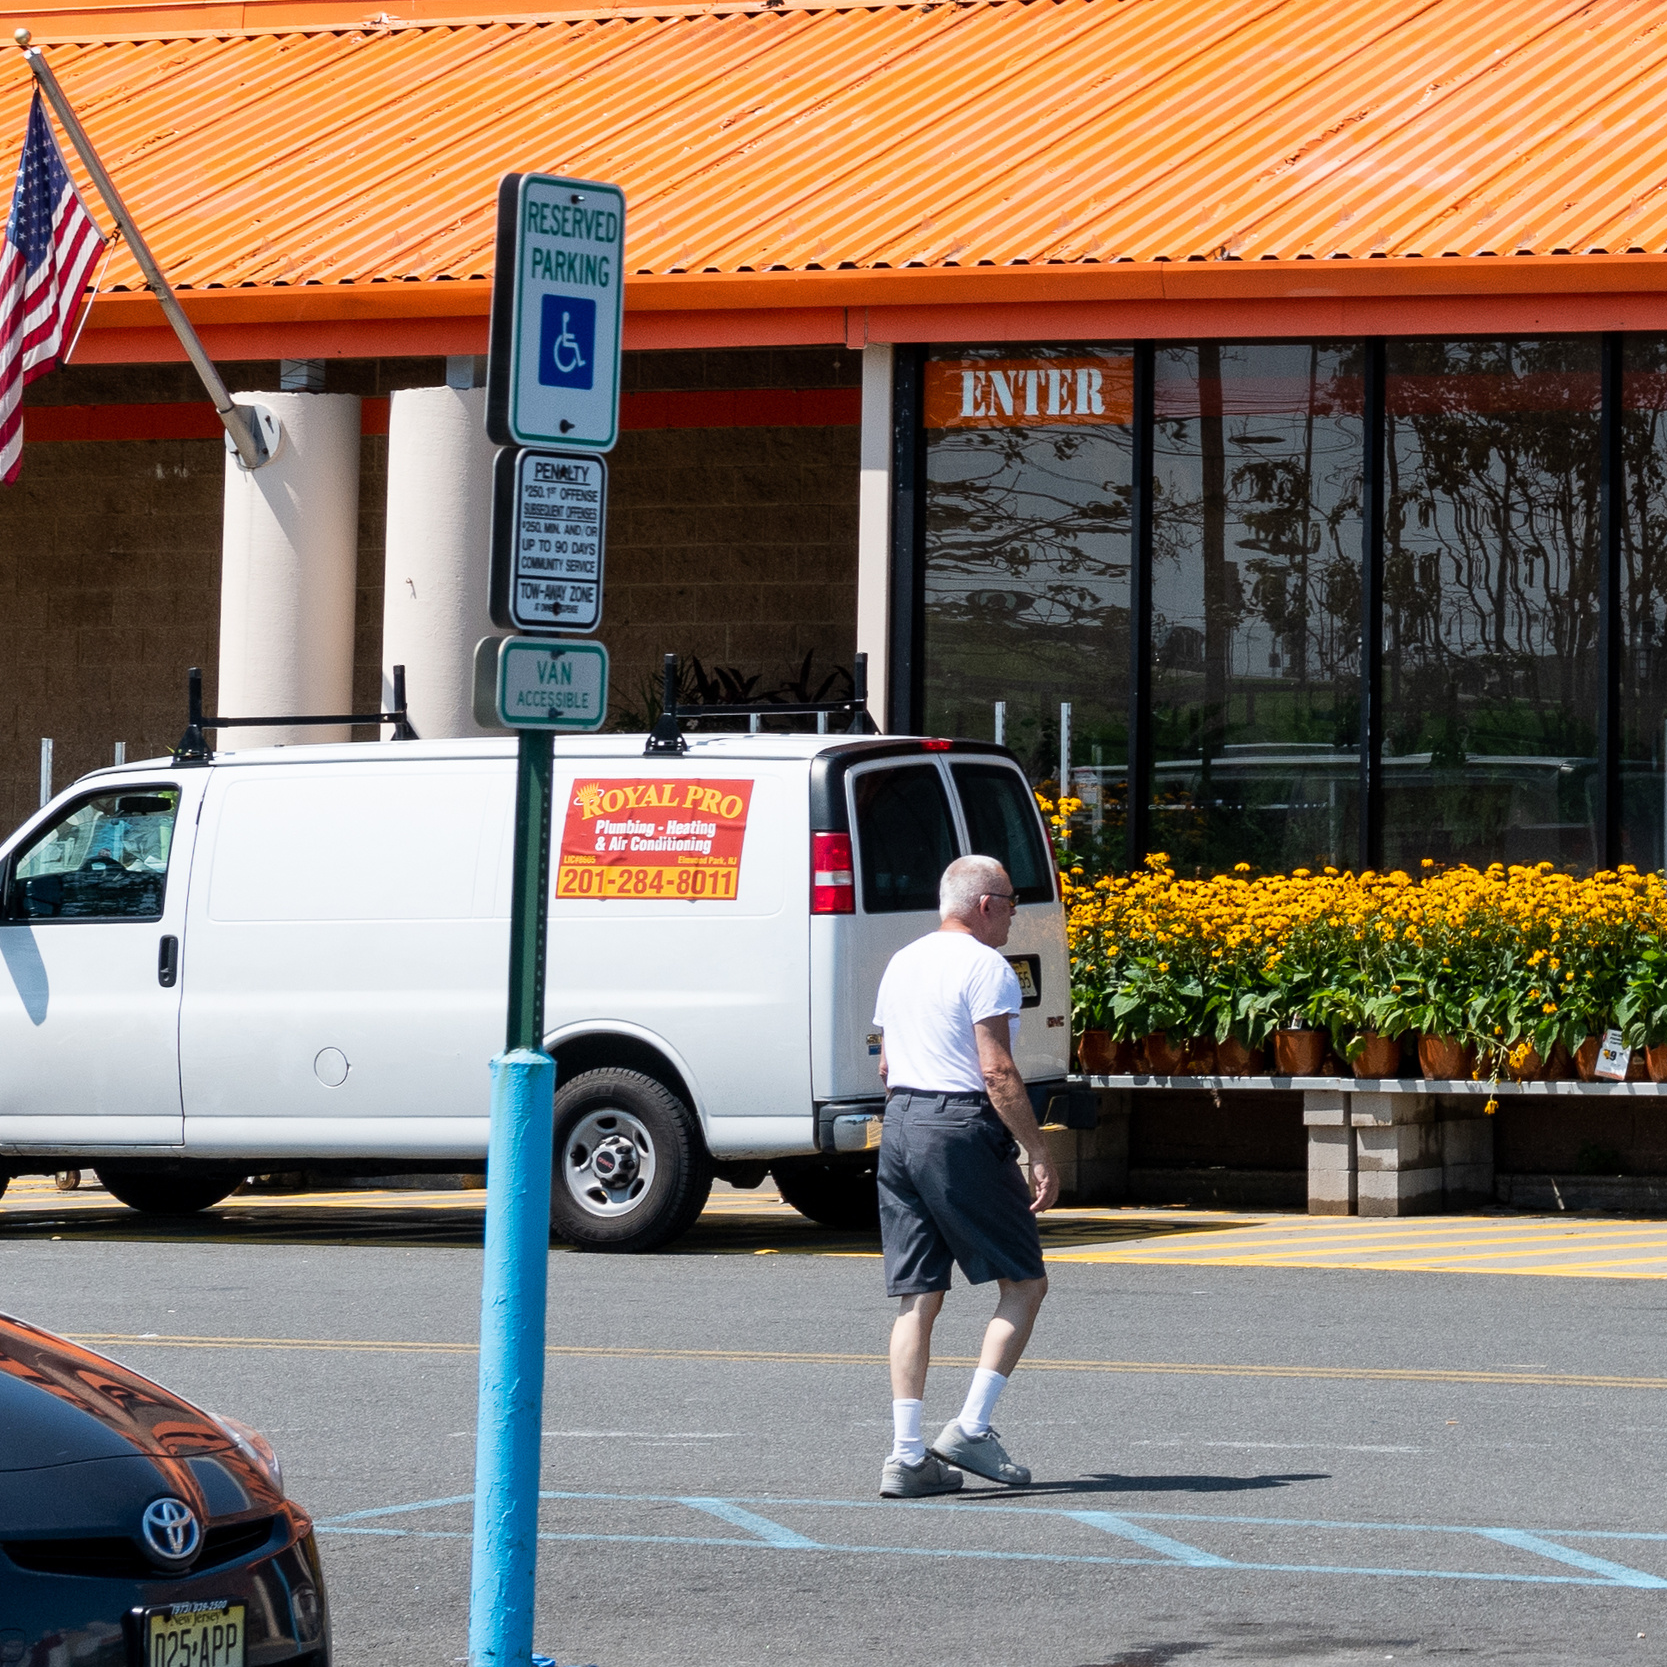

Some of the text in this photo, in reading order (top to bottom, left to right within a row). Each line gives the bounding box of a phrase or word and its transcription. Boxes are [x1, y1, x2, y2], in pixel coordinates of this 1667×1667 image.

[528, 201, 617, 243] RESERVED
[532, 248, 610, 288] PARKING
[960, 368, 1105, 417] ENTER
[560, 487, 598, 502] OFFENSE
[524, 502, 564, 518] SUBSEQUENT
[521, 538, 596, 555] UP TO 90 DAYS
[521, 556, 595, 573] COMMUNITY SERVICE
[520, 582, 594, 603] TOW-AWAY ZONE
[537, 660, 572, 685] VAN
[516, 690, 589, 709] ACCESSIBLE
[581, 784, 743, 820] ROYAL PRO
[595, 820, 655, 836] Plumbing
[666, 820, 716, 837] Heating
[595, 836, 712, 854] & Air Conditioning
[562, 869, 733, 895] 201-284-8011
[193, 1611, 222, 1626] Jersey
